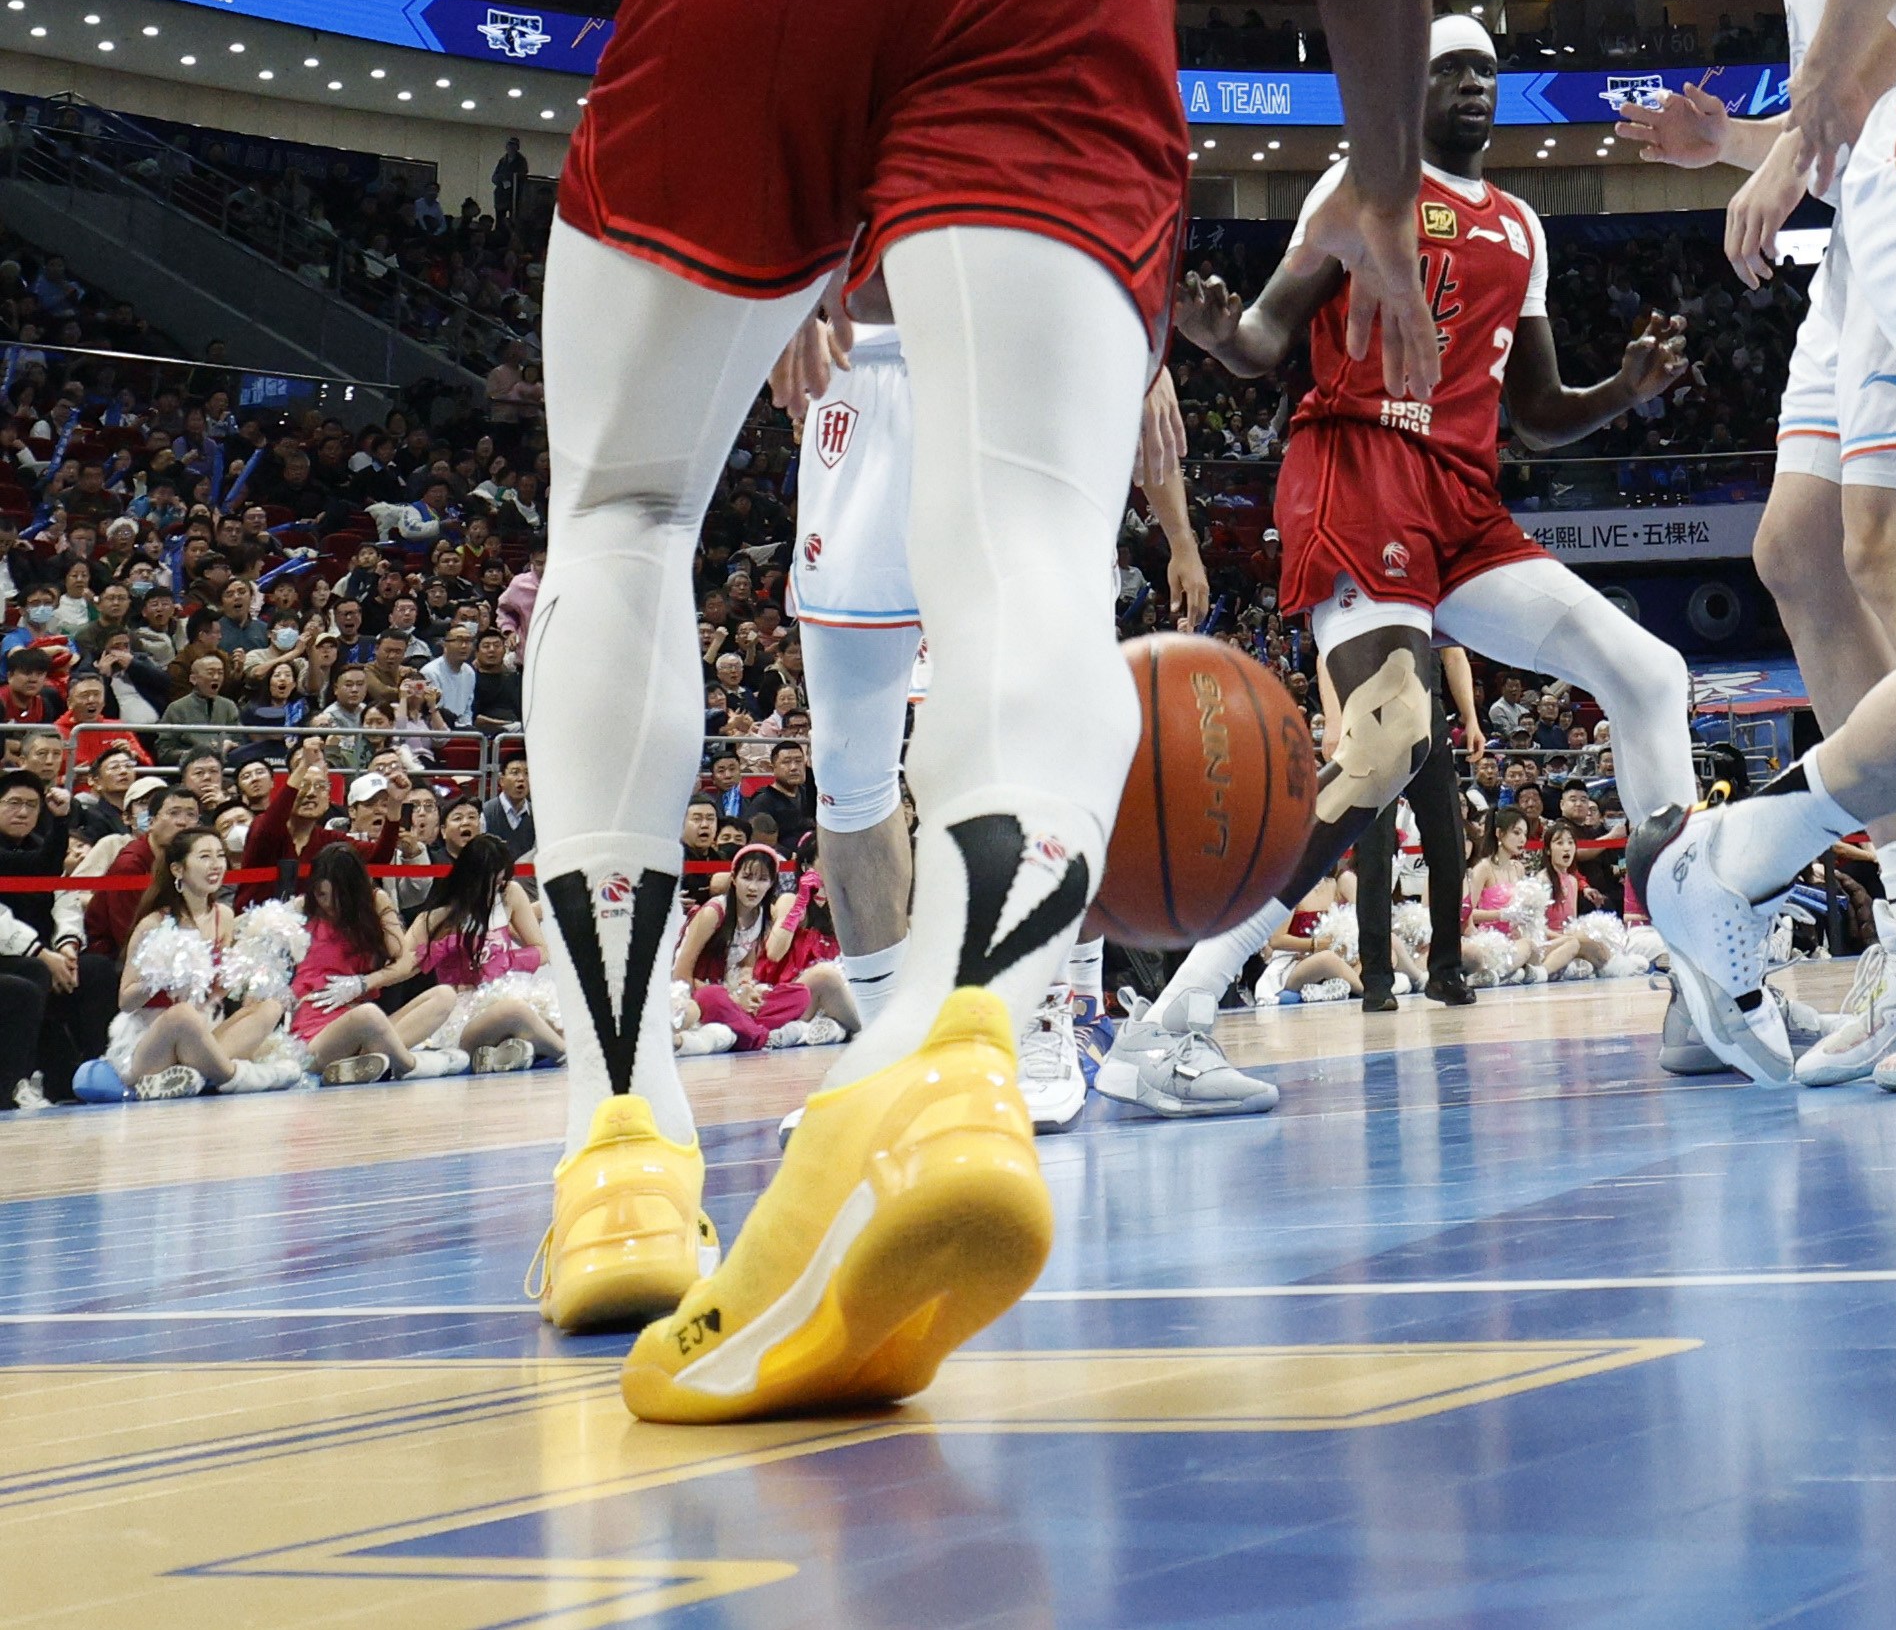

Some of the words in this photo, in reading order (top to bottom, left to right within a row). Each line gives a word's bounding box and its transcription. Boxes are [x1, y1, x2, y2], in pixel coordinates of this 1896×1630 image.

[1218, 82, 1290, 114] TEAM
[1379, 413, 1431, 436] SINCE
[1380, 400, 1432, 424] 1956
[1190, 670, 1233, 860] LI-NING
